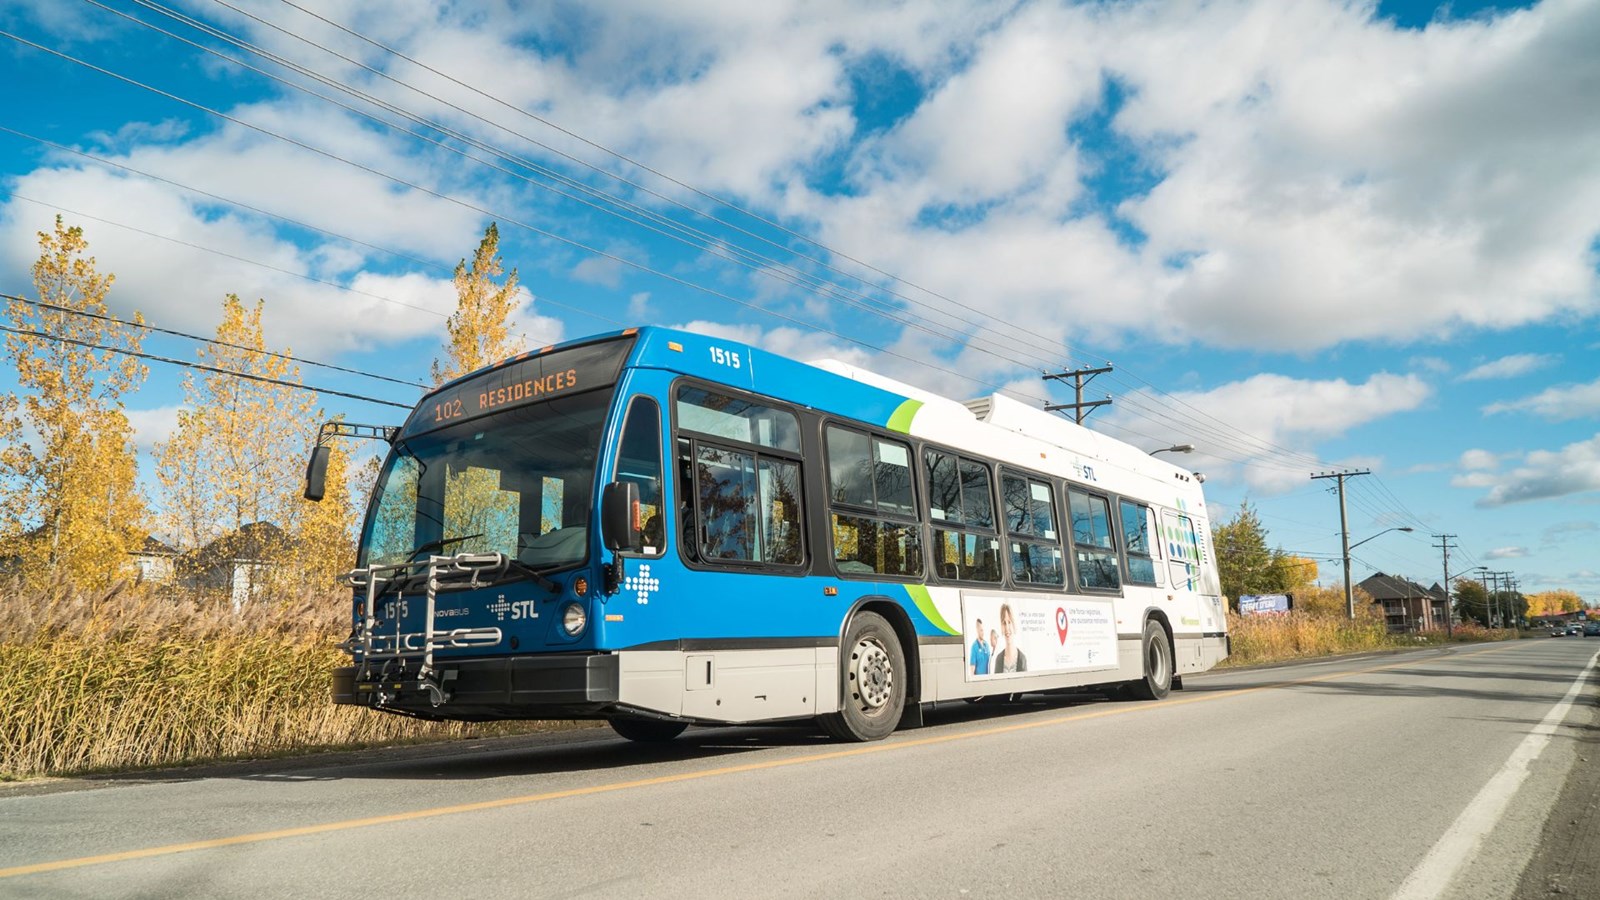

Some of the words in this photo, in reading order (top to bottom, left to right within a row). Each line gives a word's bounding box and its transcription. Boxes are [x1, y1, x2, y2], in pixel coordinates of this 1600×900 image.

[709, 346, 741, 369] 1515
[434, 399, 463, 422] 102
[479, 368, 577, 410] RESIDENCES
[1083, 465, 1097, 482] STL
[511, 600, 539, 620] STL
